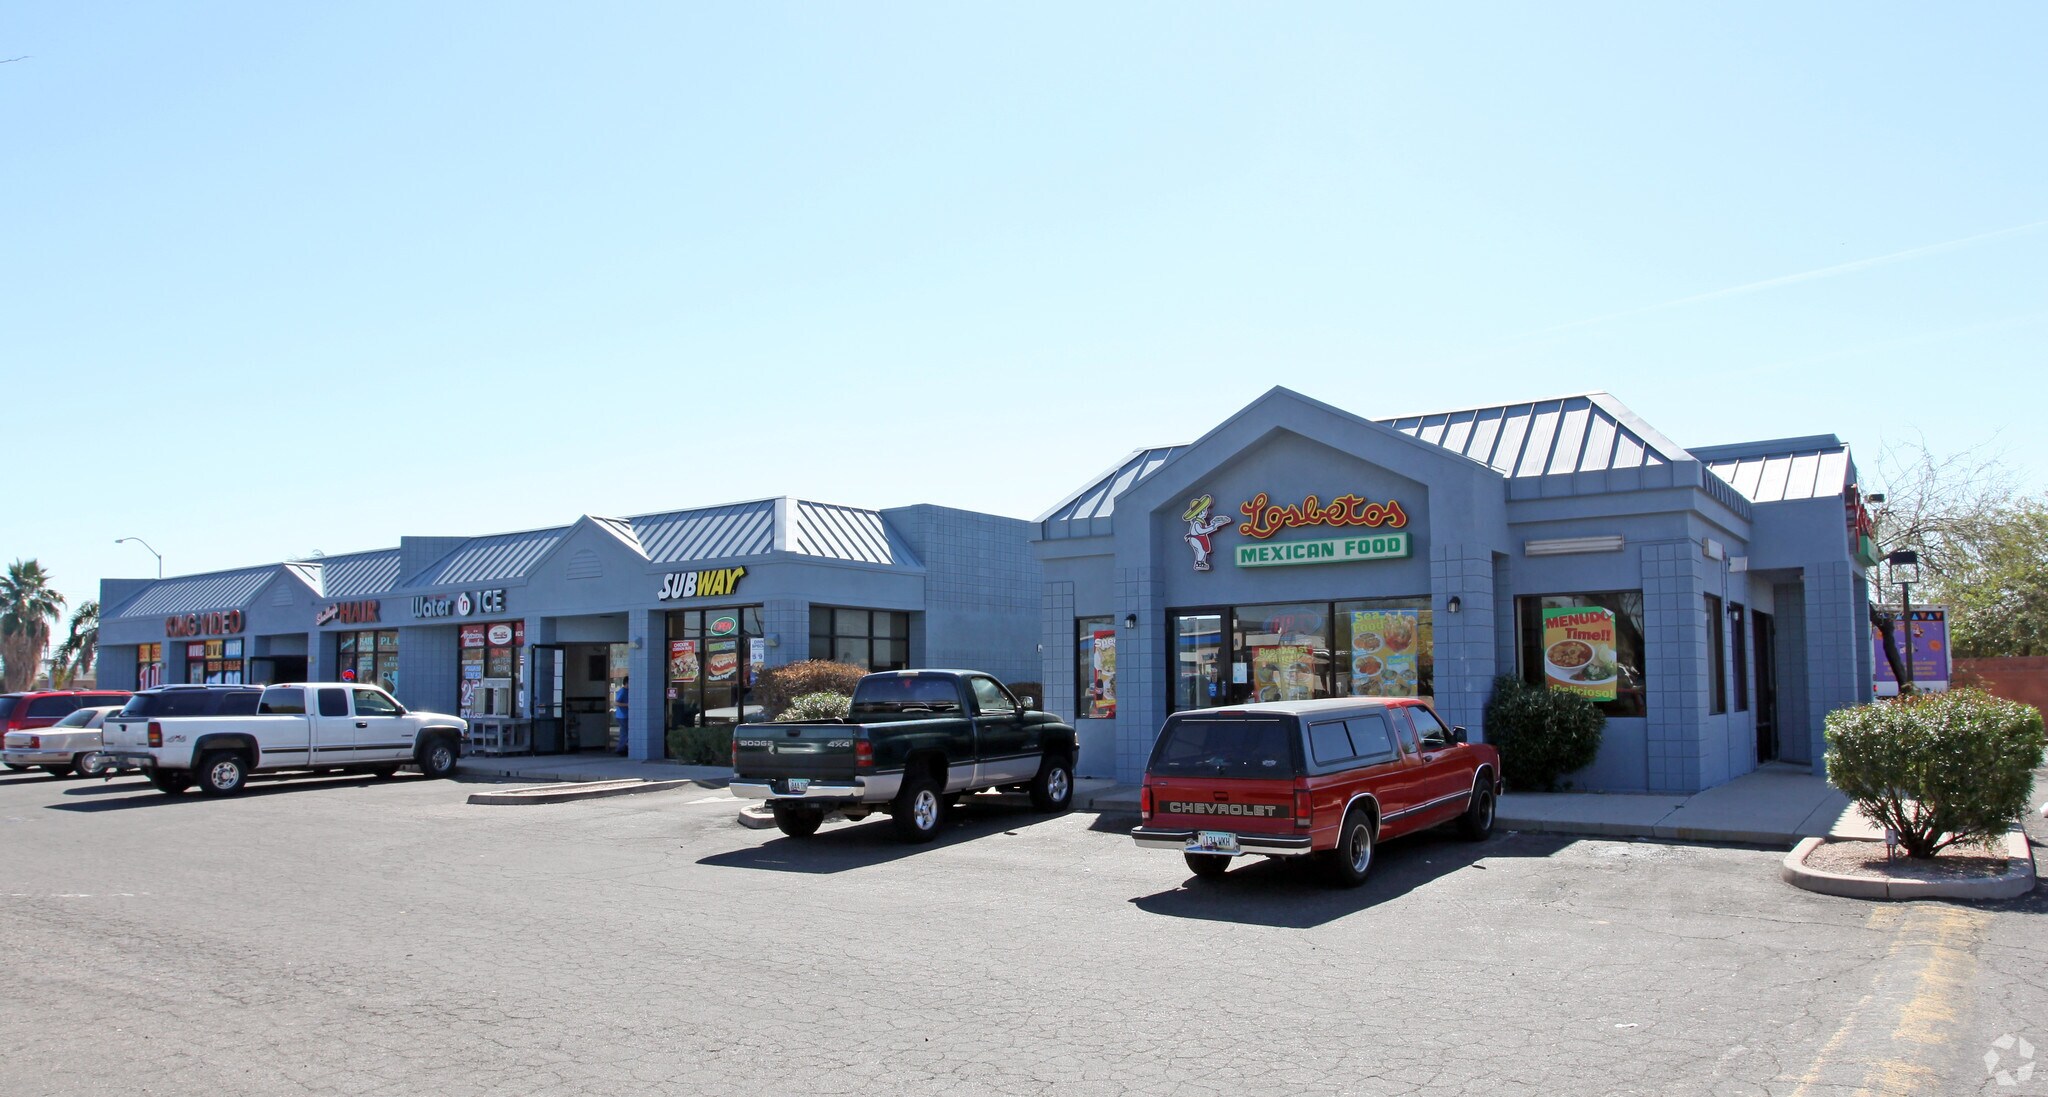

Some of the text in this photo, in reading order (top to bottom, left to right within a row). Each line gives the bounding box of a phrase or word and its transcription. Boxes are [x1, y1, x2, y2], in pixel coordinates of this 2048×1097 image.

[1239, 493, 1407, 539] Losbetos
[1240, 537, 1401, 563] MEXICAN FOOD
[657, 566, 745, 601] SUBWAY
[340, 600, 377, 624] HAIR
[411, 596, 451, 618] Water
[476, 589, 502, 613] ICE
[166, 609, 241, 638] KING VIDEO
[714, 621, 733, 632] OPEN
[1355, 611, 1380, 622] Sea
[1546, 611, 1612, 629] MENUDO
[1565, 628, 1611, 641] Time!!
[1169, 802, 1277, 816] CHEVROLET
